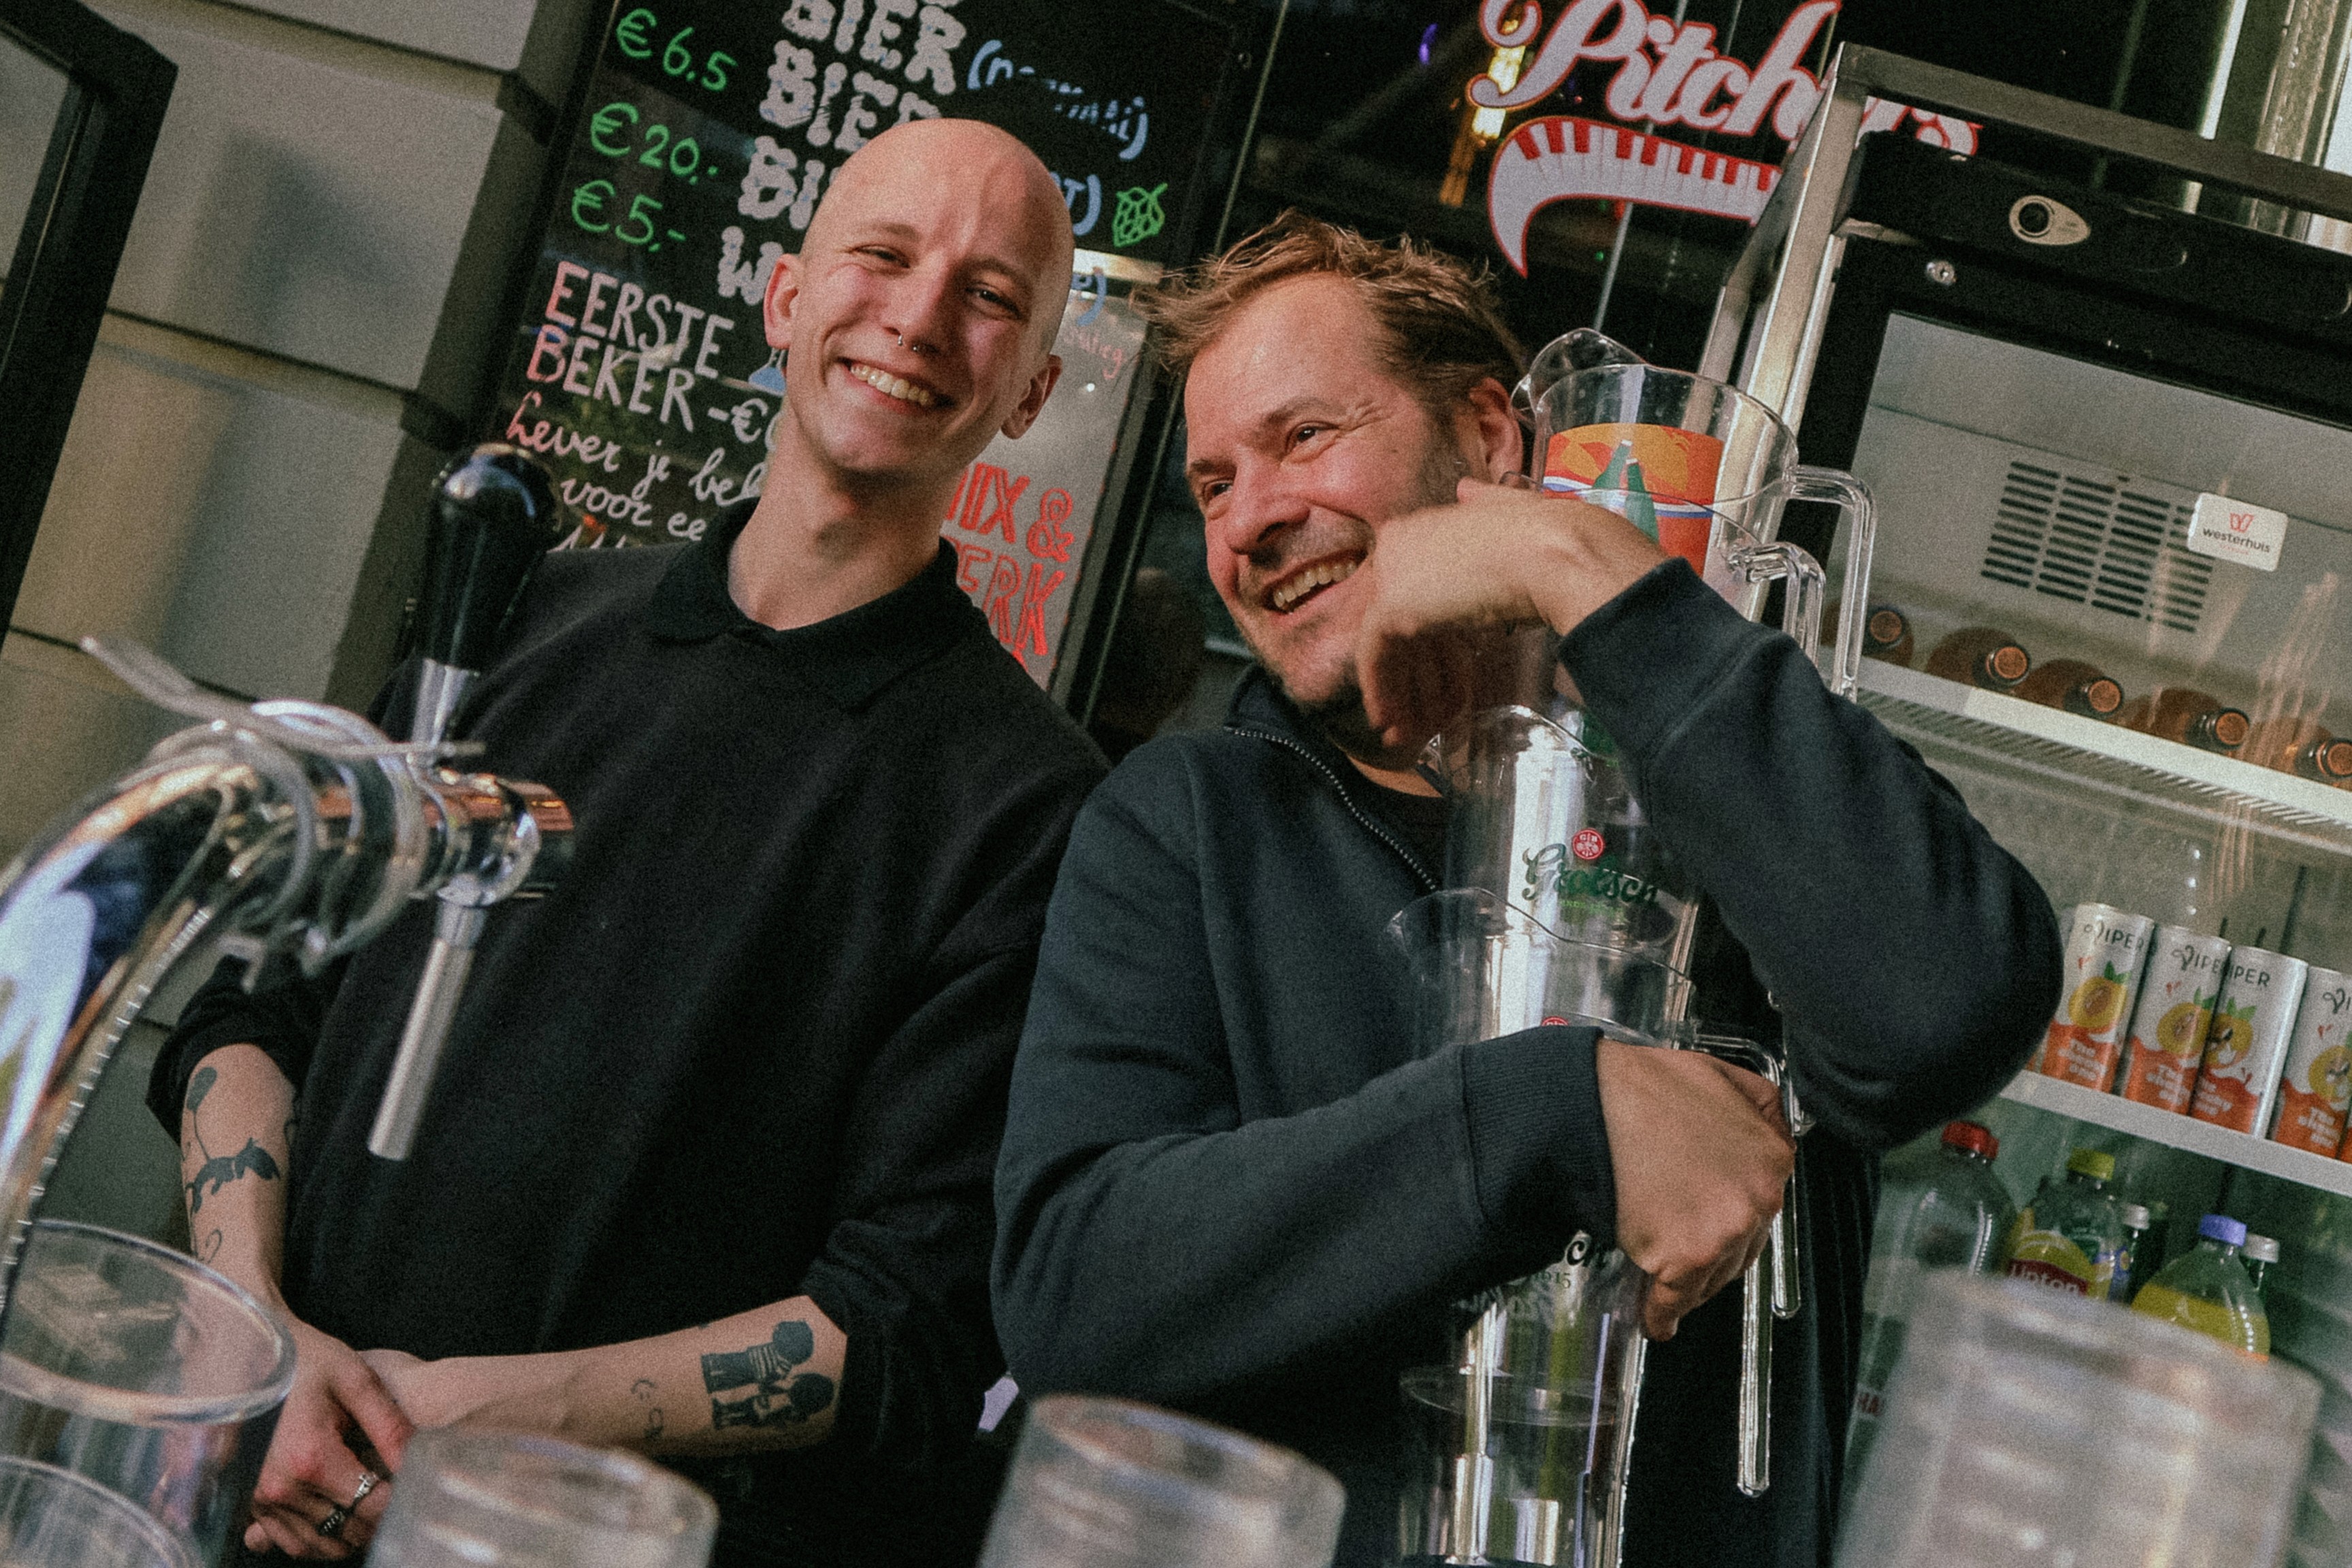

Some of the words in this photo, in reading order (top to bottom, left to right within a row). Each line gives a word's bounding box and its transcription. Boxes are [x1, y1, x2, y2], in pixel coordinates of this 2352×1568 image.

[546, 261, 734, 379] EERSTE
[527, 324, 693, 431] BEKER
[632, 439, 670, 501] je
[561, 478, 653, 527] voor
[2202, 527, 2270, 553] westerhuis
